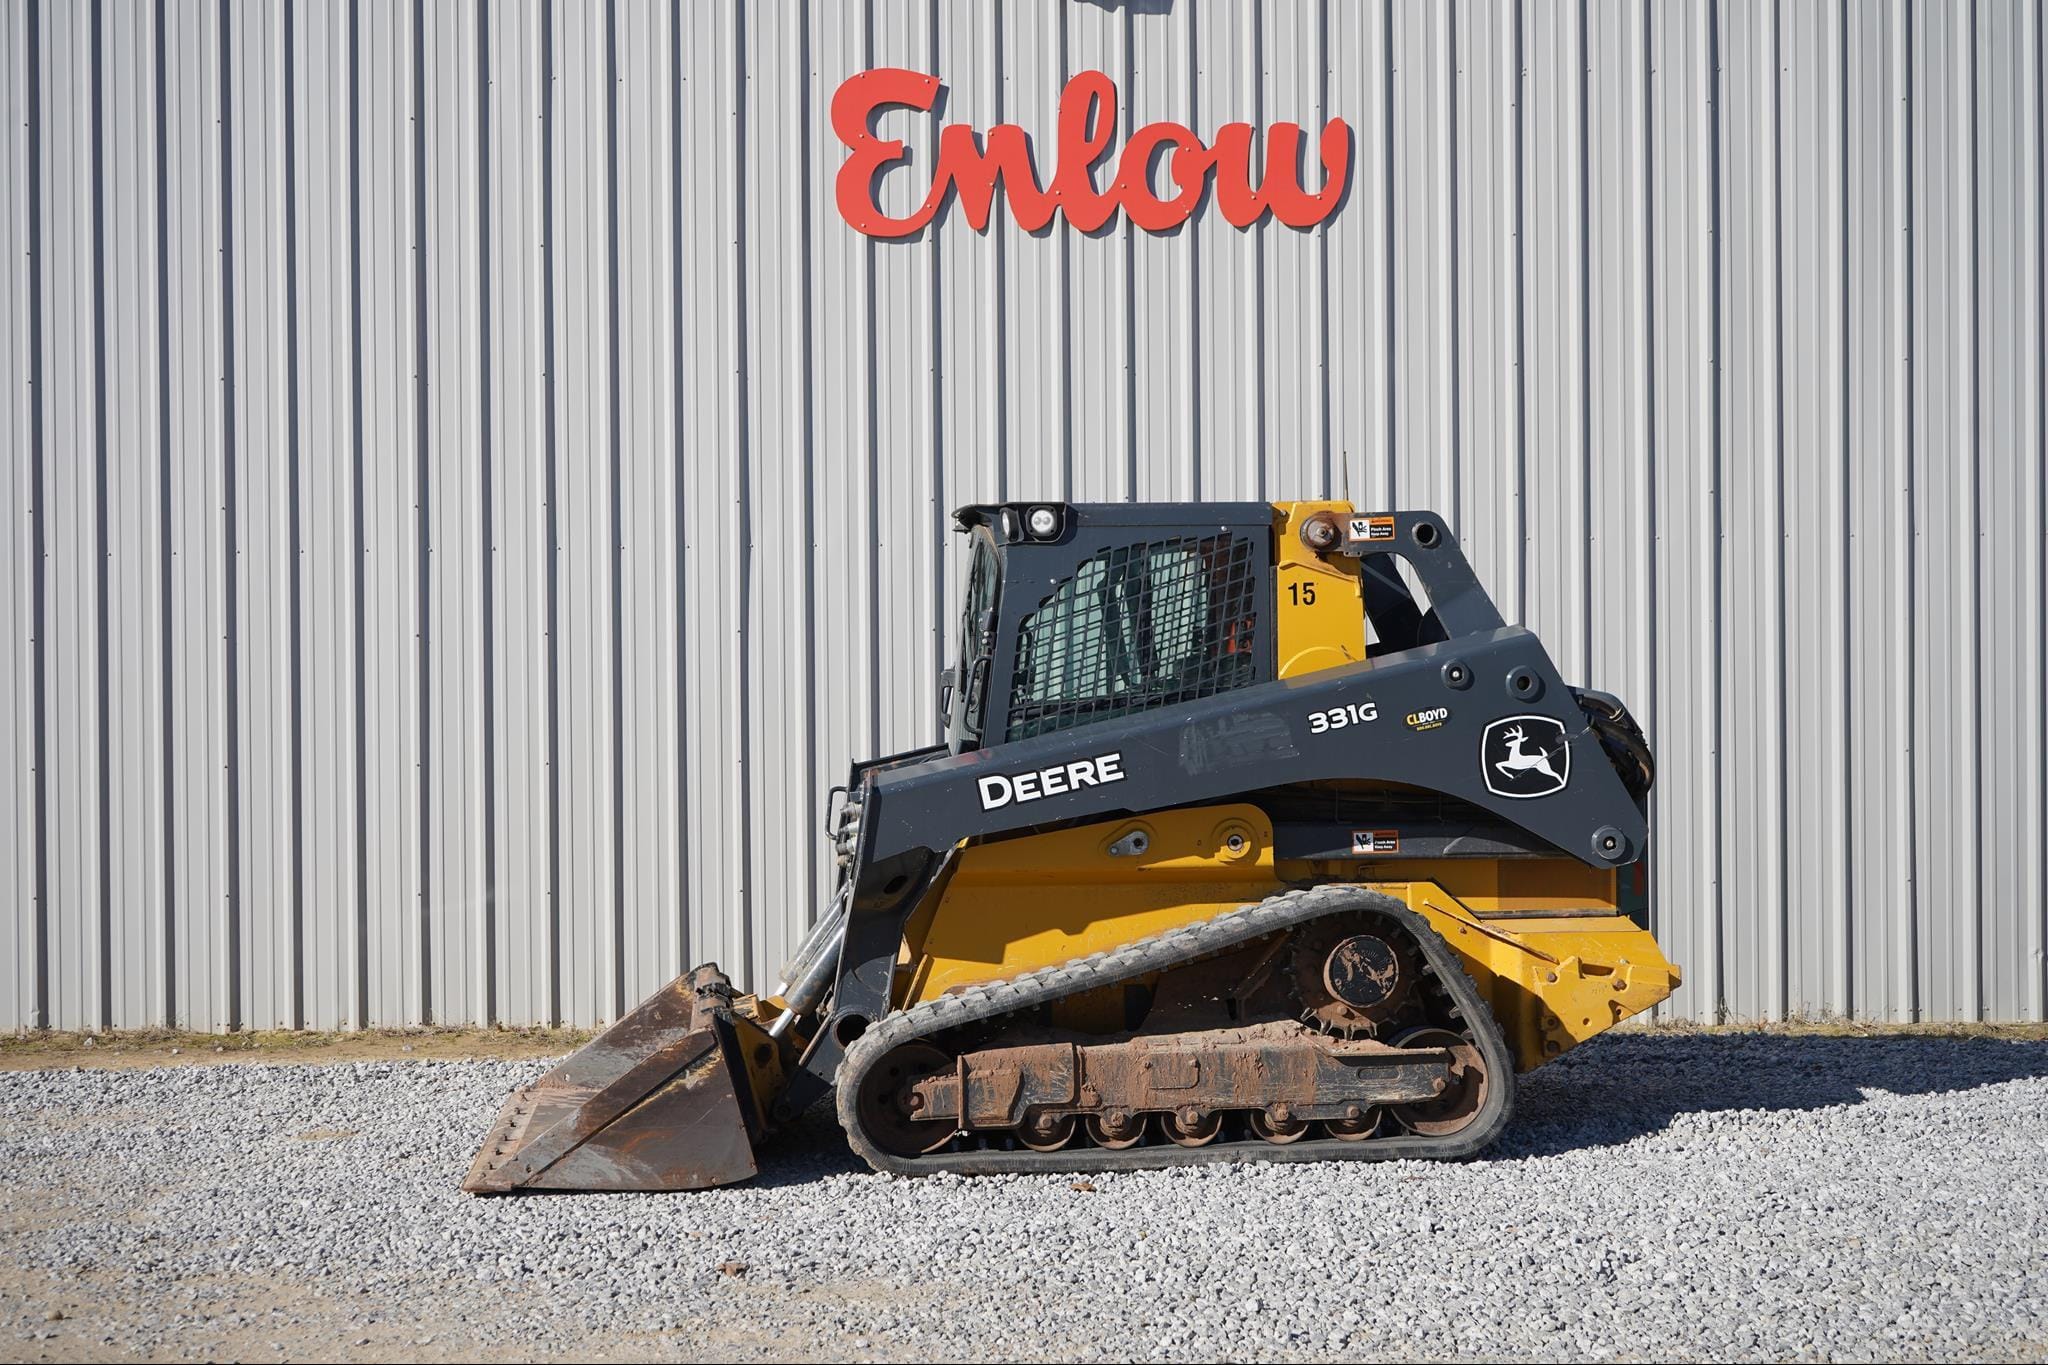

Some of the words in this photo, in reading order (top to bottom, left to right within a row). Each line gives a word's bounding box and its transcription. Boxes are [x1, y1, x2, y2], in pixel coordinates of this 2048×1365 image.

[831, 68, 1348, 238] Enlow
[1288, 582, 1315, 606] 15
[1308, 702, 1378, 733] 331G
[978, 753, 1124, 810] DEERE
